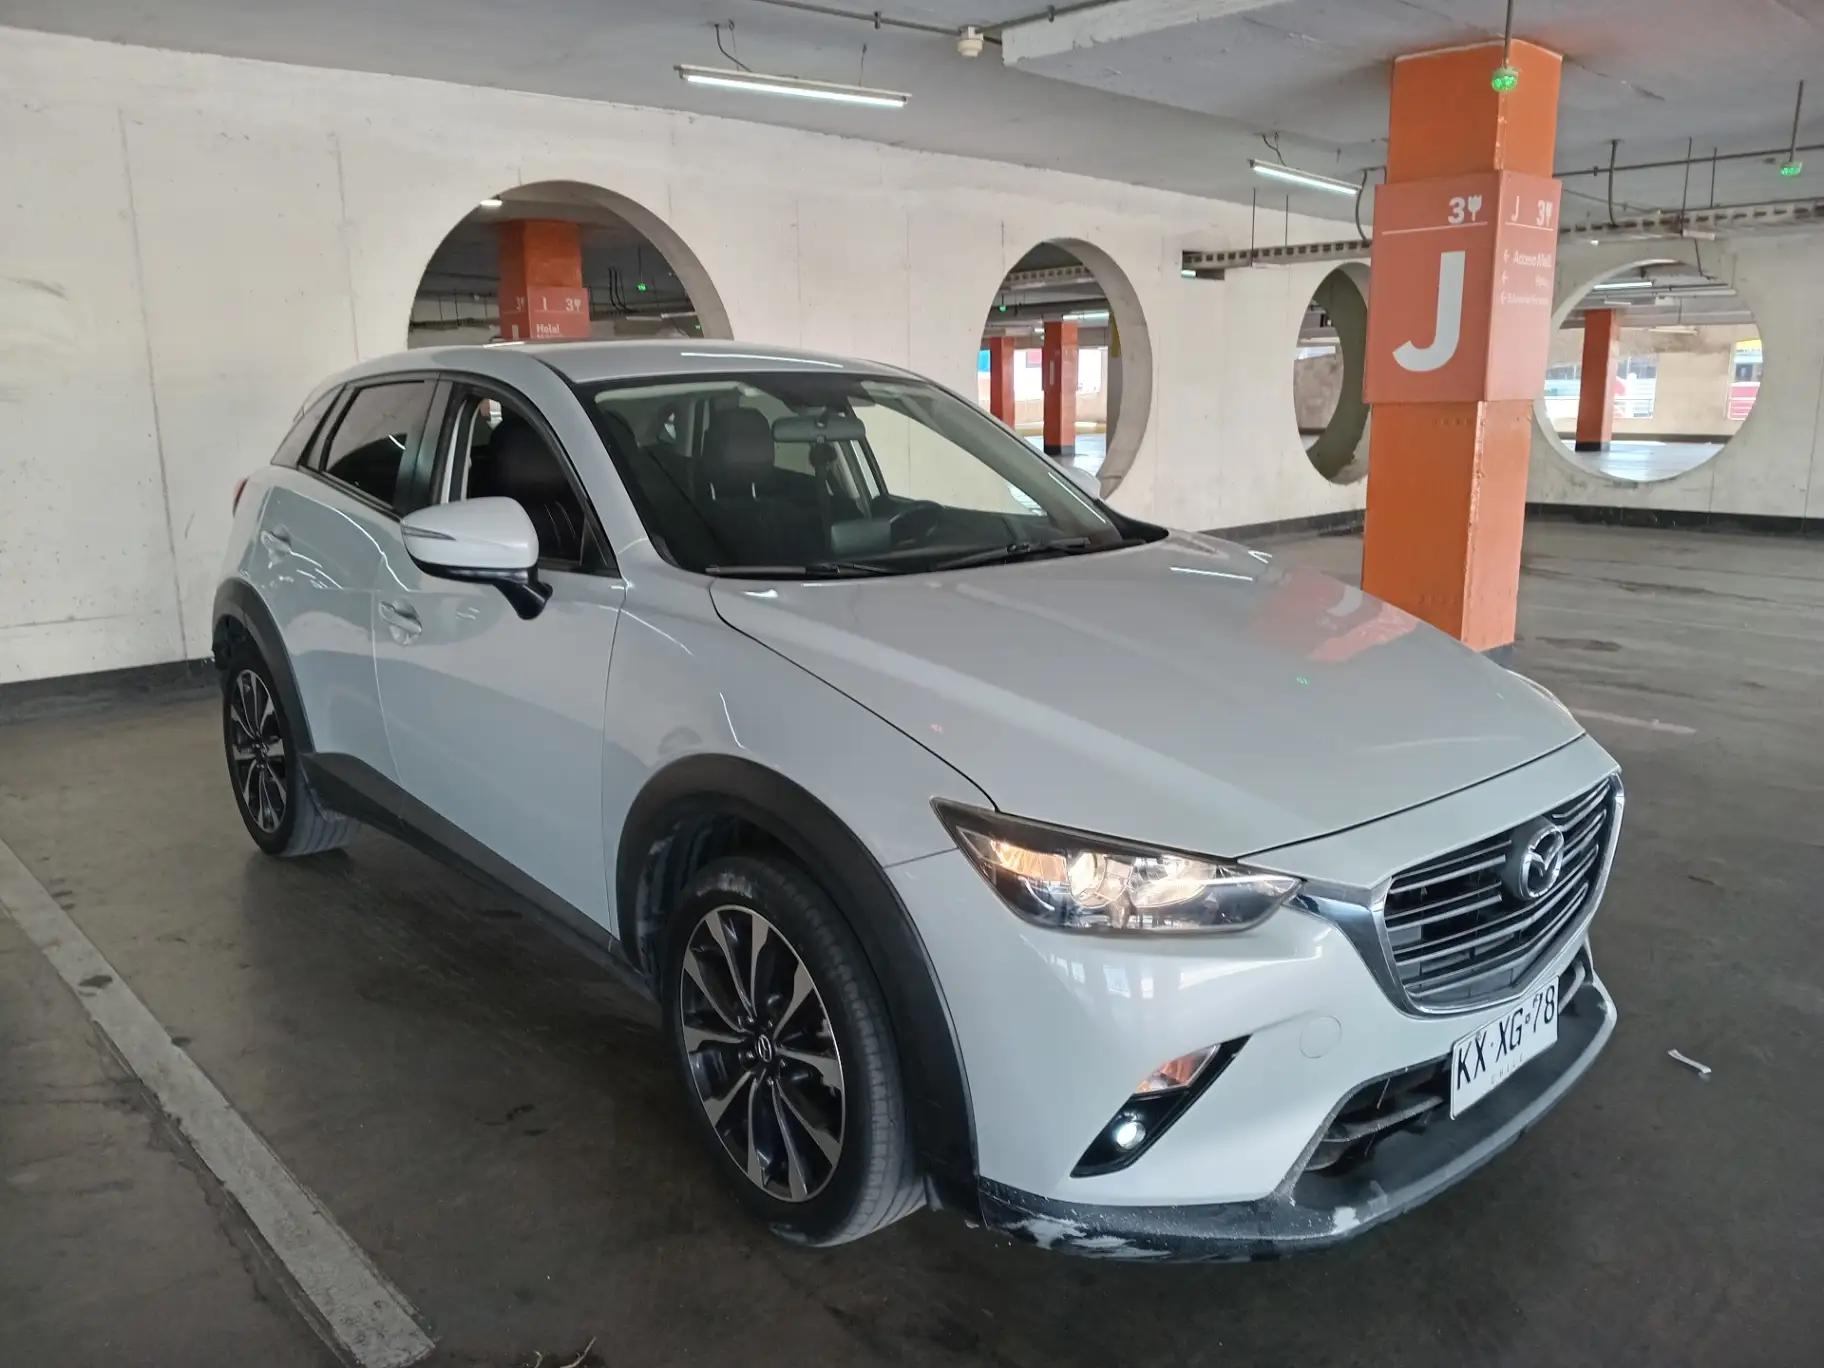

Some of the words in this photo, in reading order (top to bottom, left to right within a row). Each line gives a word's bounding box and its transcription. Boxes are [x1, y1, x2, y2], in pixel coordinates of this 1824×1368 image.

[1447, 196, 1466, 225] 3
[1511, 195, 1520, 222] J
[1536, 200, 1546, 226] 3
[565, 298, 574, 312] 3
[1392, 250, 1466, 372] J
